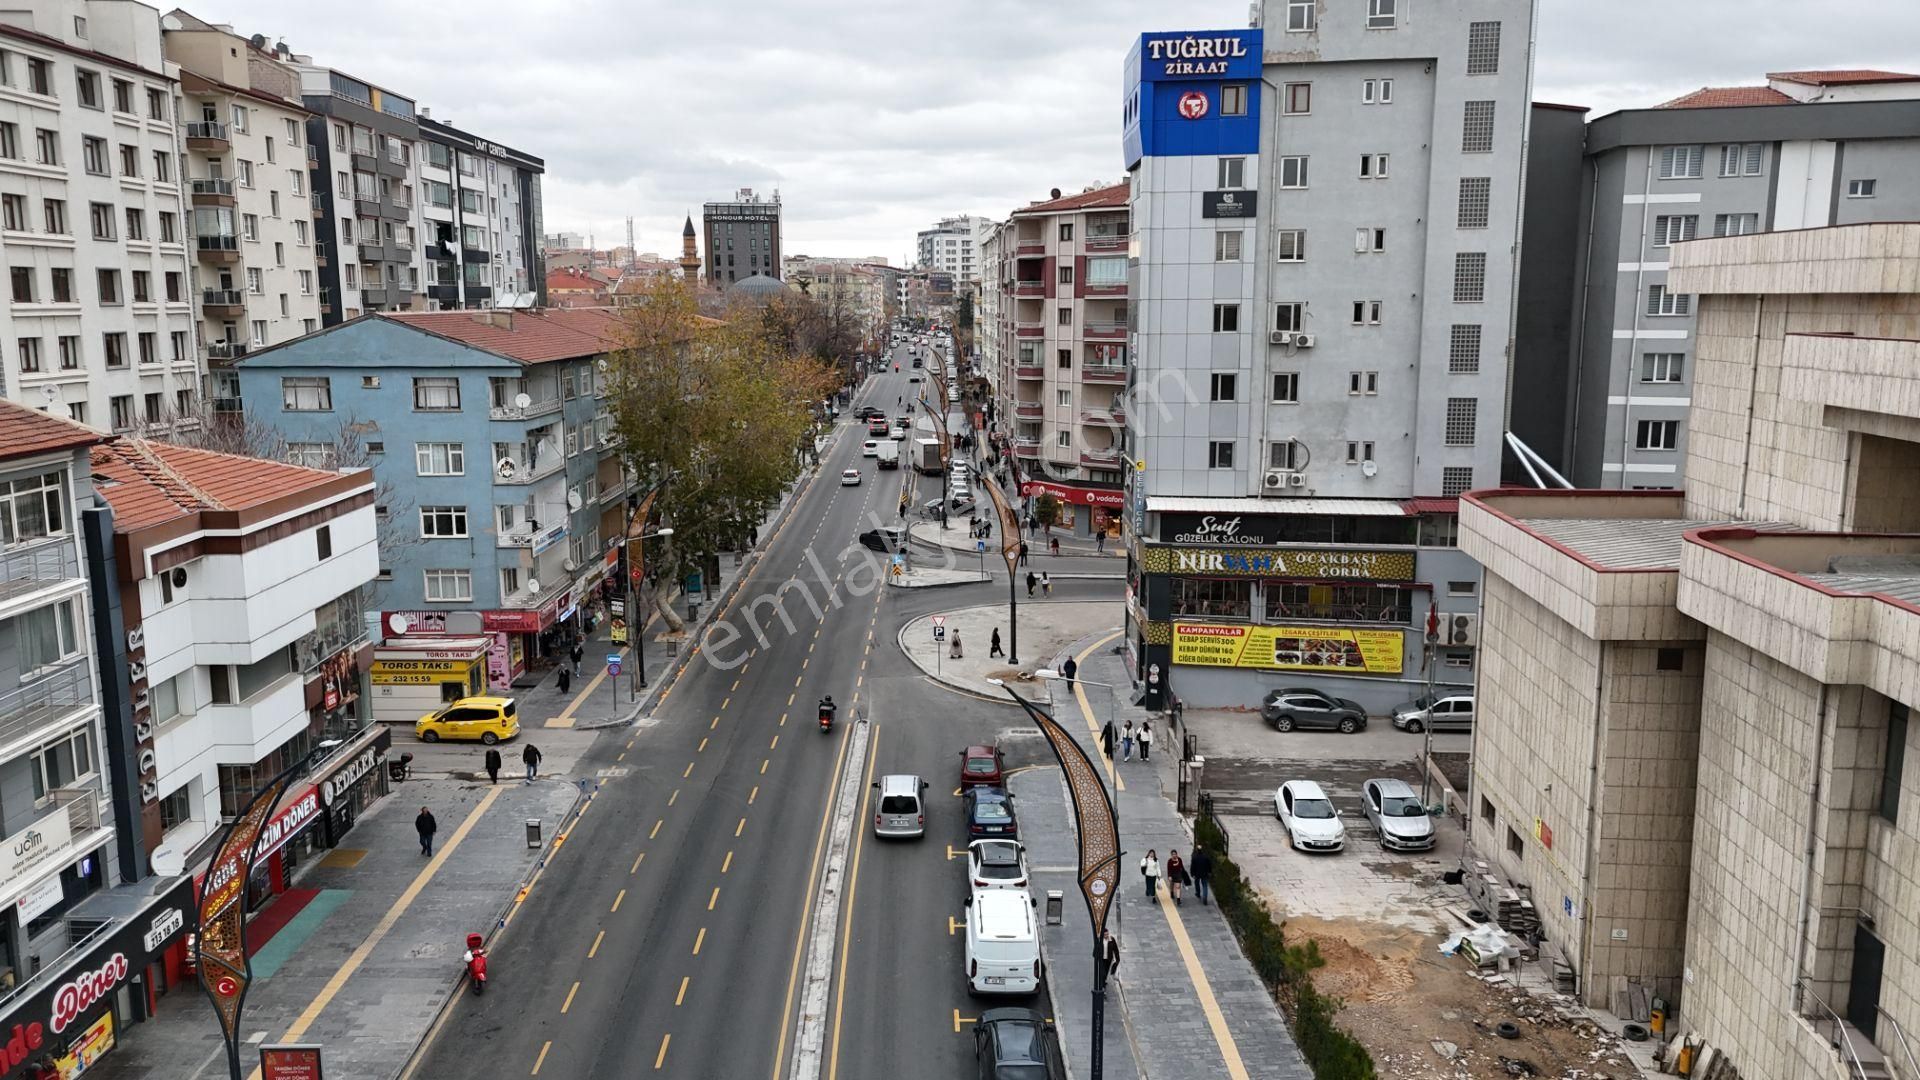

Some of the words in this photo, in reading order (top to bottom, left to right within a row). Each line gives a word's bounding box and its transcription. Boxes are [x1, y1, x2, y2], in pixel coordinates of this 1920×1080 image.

[1148, 36, 1247, 58] TUĞRUL
[1166, 60, 1228, 74] ZİRAAT
[1096, 495, 1124, 503] vodafon
[1196, 515, 1241, 536] Suit
[1174, 533, 1220, 543] GÜZELLİK
[1222, 535, 1264, 544] SALONU
[1320, 567, 1370, 578] ÇORBA
[936, 627, 944, 636] P
[1180, 626, 1242, 636] KAMPANYALAR
[1179, 635, 1199, 643] KEBAP
[1178, 645, 1199, 653] KEBAP
[1200, 645, 1221, 654] DÜRÜM
[1196, 654, 1218, 663] DÜRÜM
[381, 662, 419, 670] TOROS
[283, 794, 317, 834] DÖNER
[52, 953, 128, 1033] Döner
